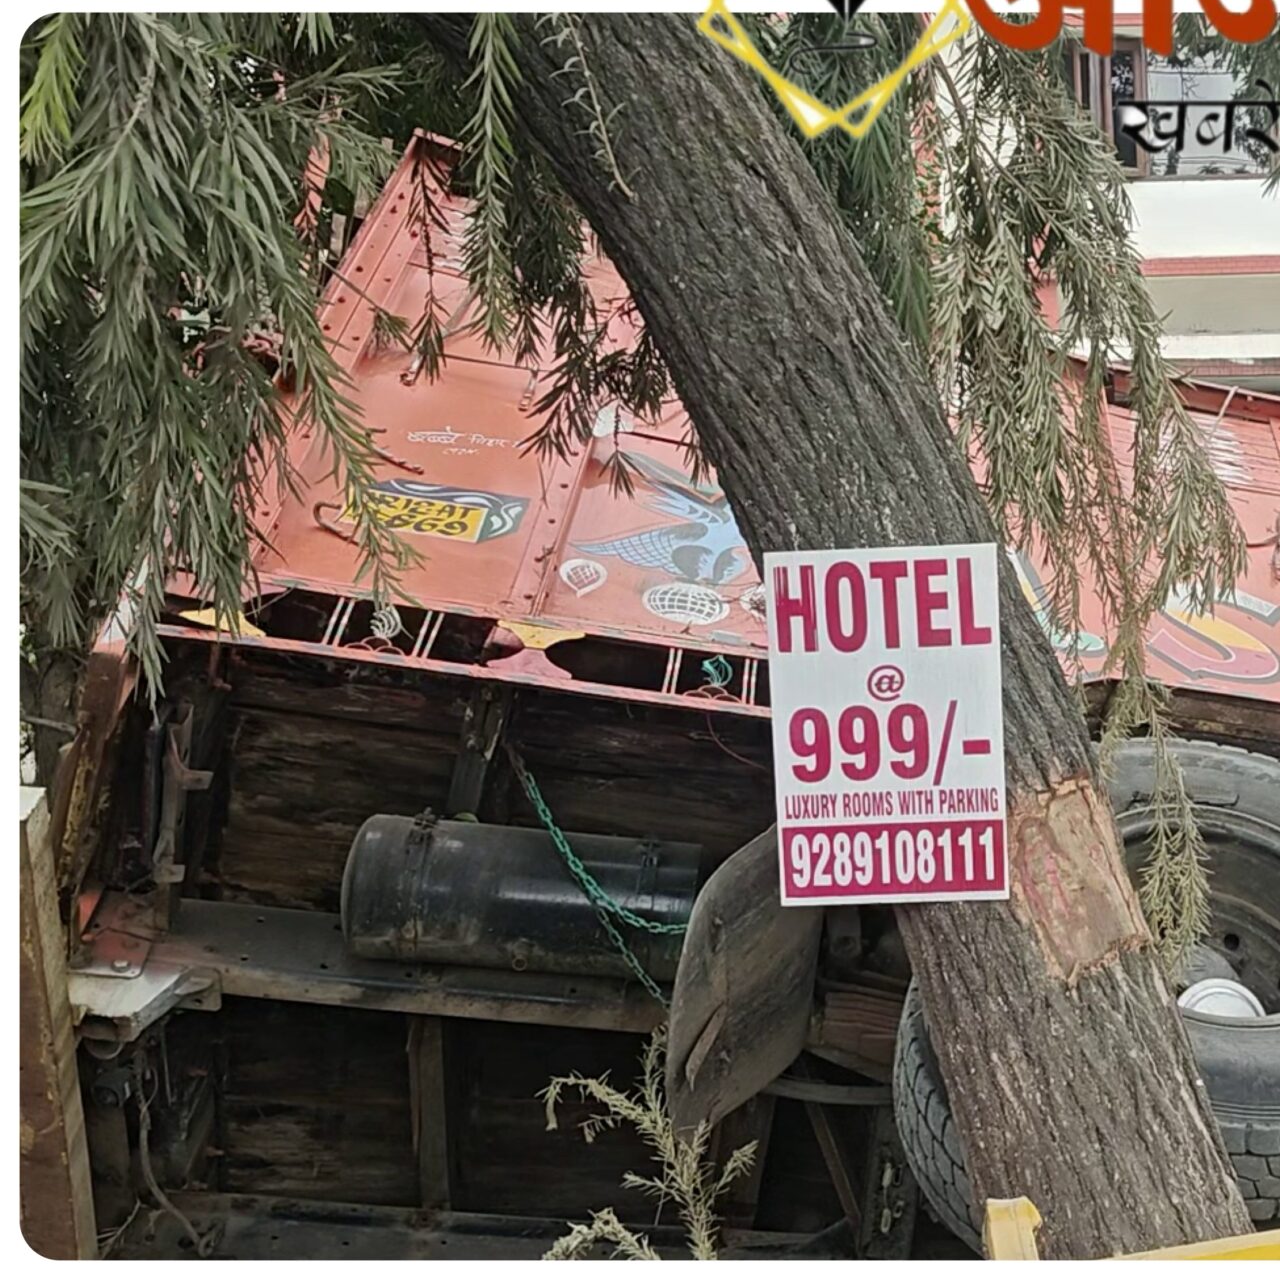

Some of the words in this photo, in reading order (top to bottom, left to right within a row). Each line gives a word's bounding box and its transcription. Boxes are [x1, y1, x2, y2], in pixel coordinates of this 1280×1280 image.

[774, 558, 992, 653] HOTEL
[867, 665, 905, 701] @
[789, 700, 991, 786] 999/-
[785, 793, 838, 820] LUXURY
[842, 791, 893, 818] ROOMS
[898, 789, 934, 816] WITH
[939, 787, 999, 815] PARKING
[790, 826, 996, 888] 9289108111
